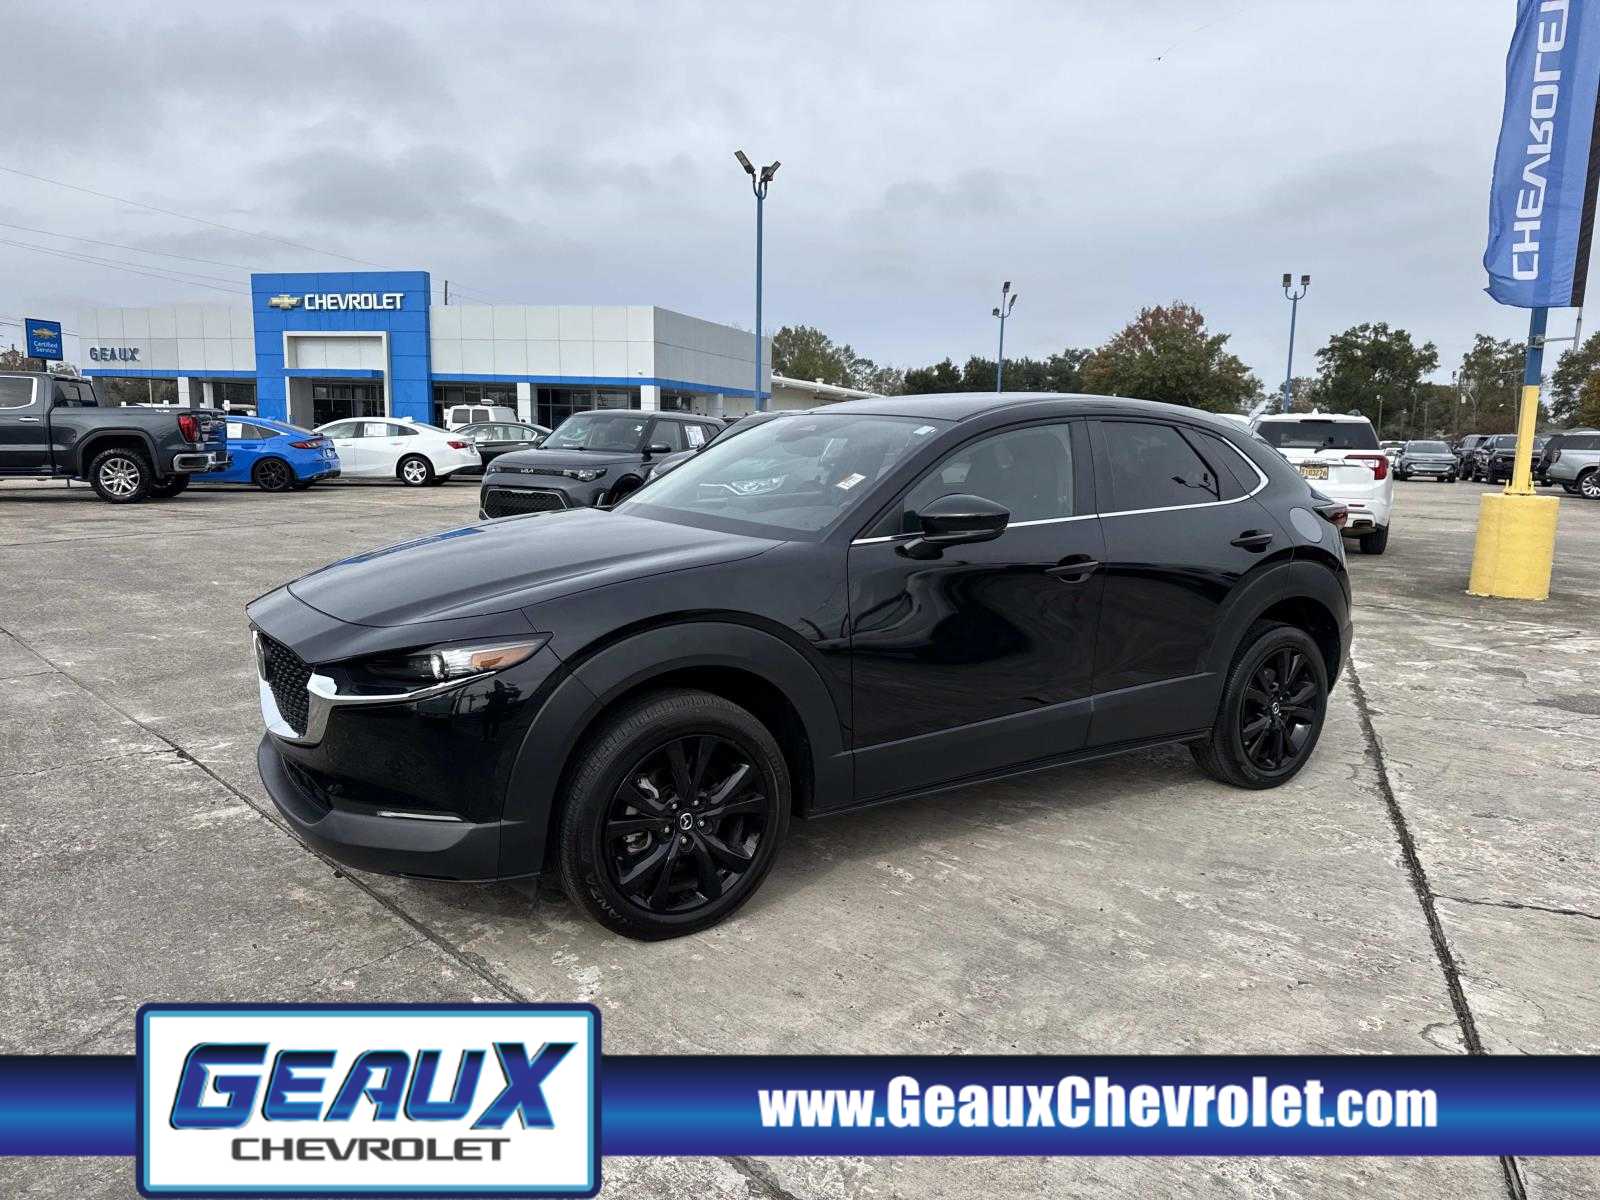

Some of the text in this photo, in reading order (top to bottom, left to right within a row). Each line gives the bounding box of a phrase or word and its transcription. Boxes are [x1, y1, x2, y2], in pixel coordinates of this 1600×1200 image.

[304, 293, 404, 310] CHEVROLET
[33, 340, 58, 349] Certified
[89, 347, 140, 361] GEAUX
